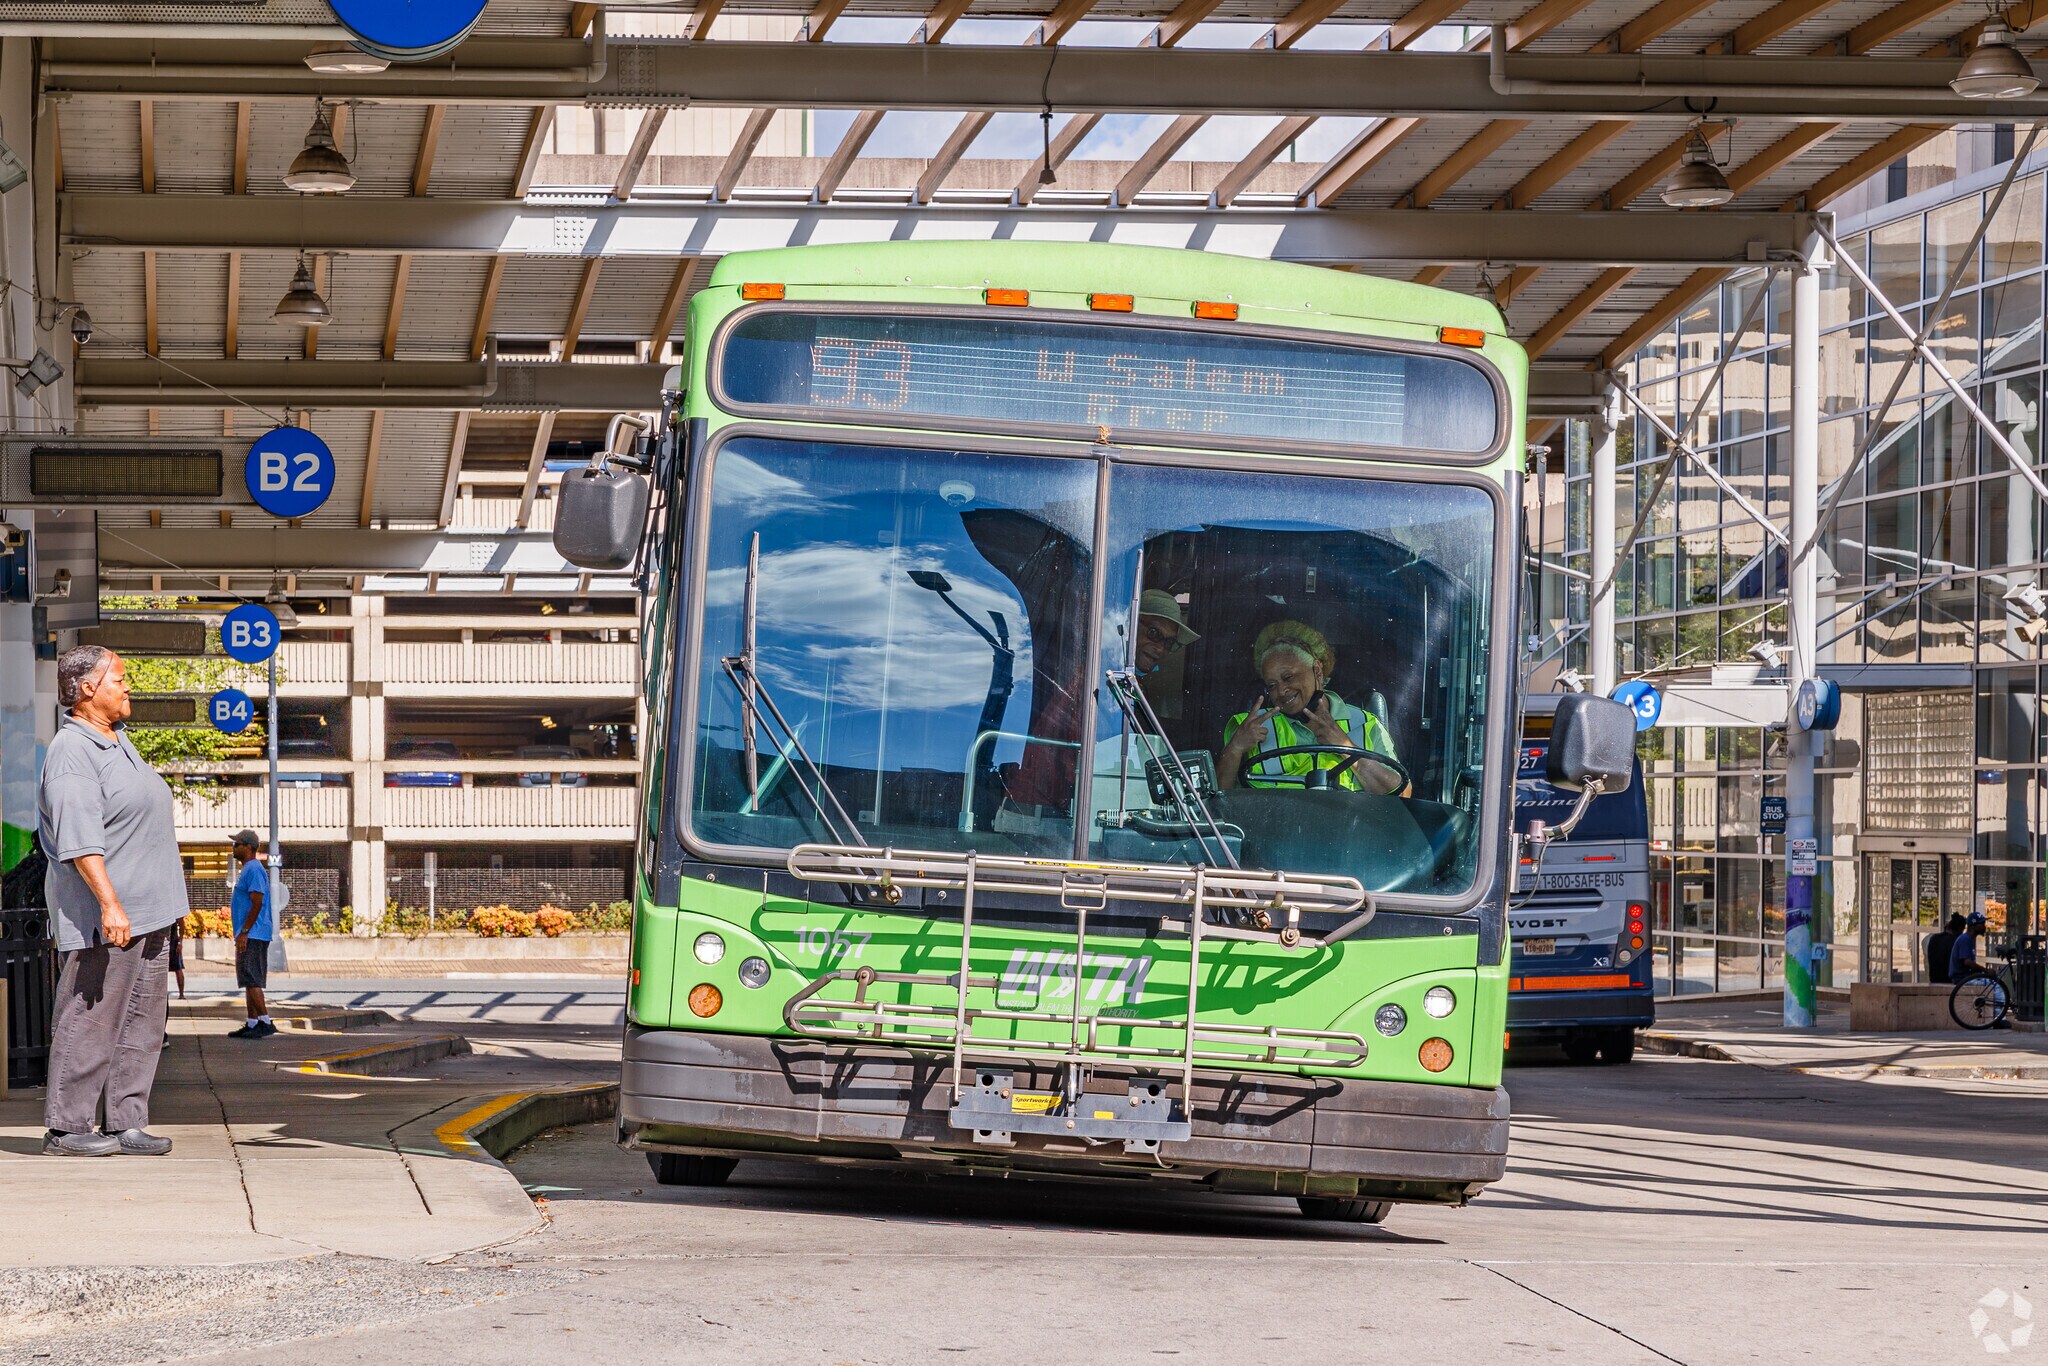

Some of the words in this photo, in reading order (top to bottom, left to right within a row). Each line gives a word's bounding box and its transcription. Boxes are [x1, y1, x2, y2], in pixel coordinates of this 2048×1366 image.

[810, 336, 911, 410] 93
[1037, 349, 1074, 383] W
[1106, 354, 1284, 396] Salem
[259, 452, 321, 492] B2
[231, 620, 271, 648] B3
[215, 700, 248, 721] B4
[1623, 693, 1656, 718] A3
[1800, 694, 1816, 717] A3
[1762, 812, 1785, 820] STOP
[1542, 873, 1625, 889] 1-800-SAFE-BUS
[1510, 919, 1567, 928] VOST
[794, 926, 873, 959] 1057
[1593, 956, 1609, 967] X3
[998, 948, 1152, 1005] WSTA
[1061, 1003, 1094, 1015] TRASIT
